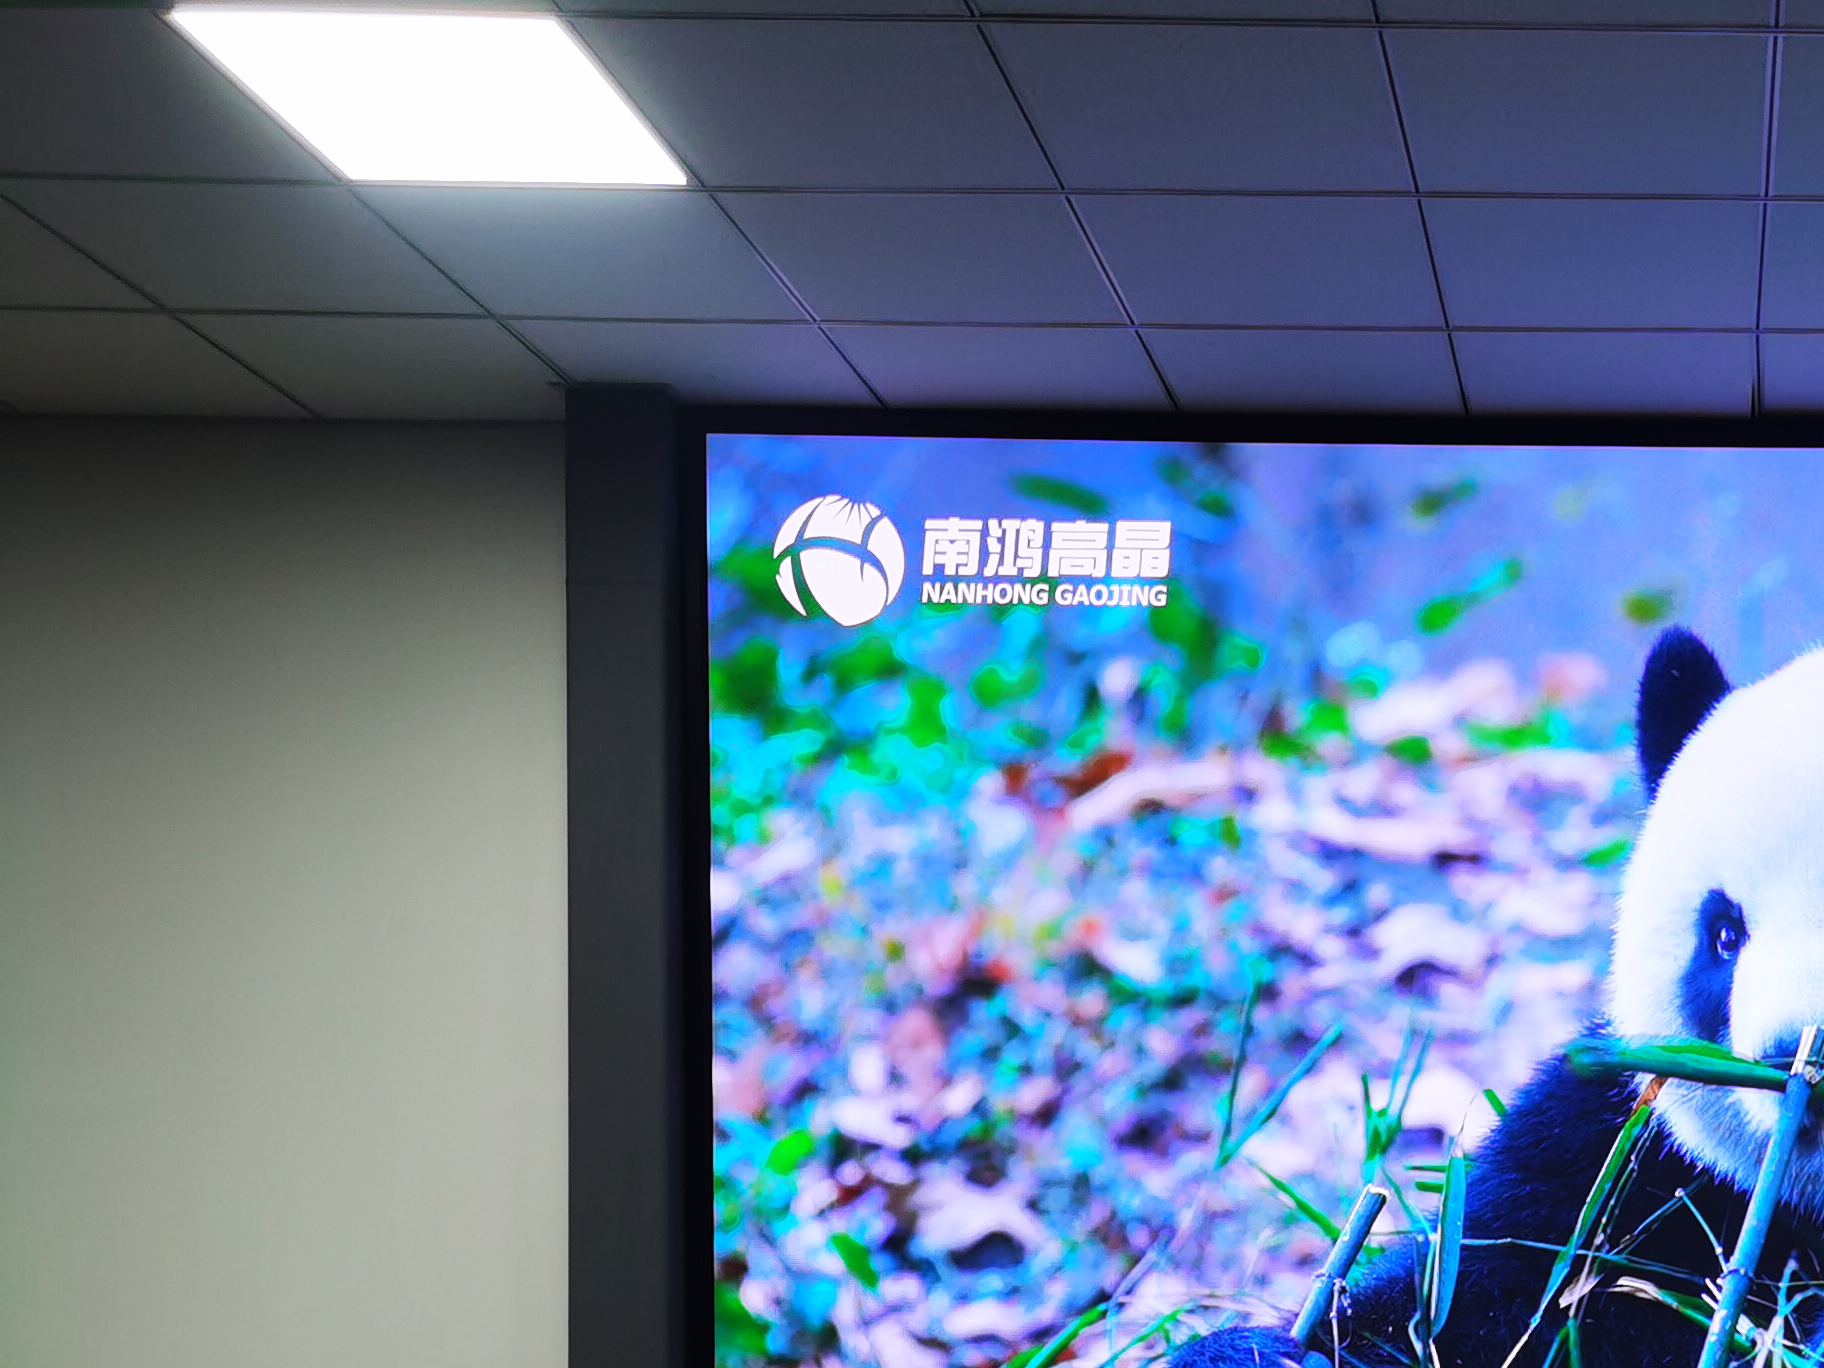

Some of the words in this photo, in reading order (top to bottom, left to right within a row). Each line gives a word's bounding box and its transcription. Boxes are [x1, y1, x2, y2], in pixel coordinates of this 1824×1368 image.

[922, 517, 1172, 578] 南鸿高晶
[921, 583, 1050, 606] NANHONG
[1054, 584, 1168, 607] GAOJING
